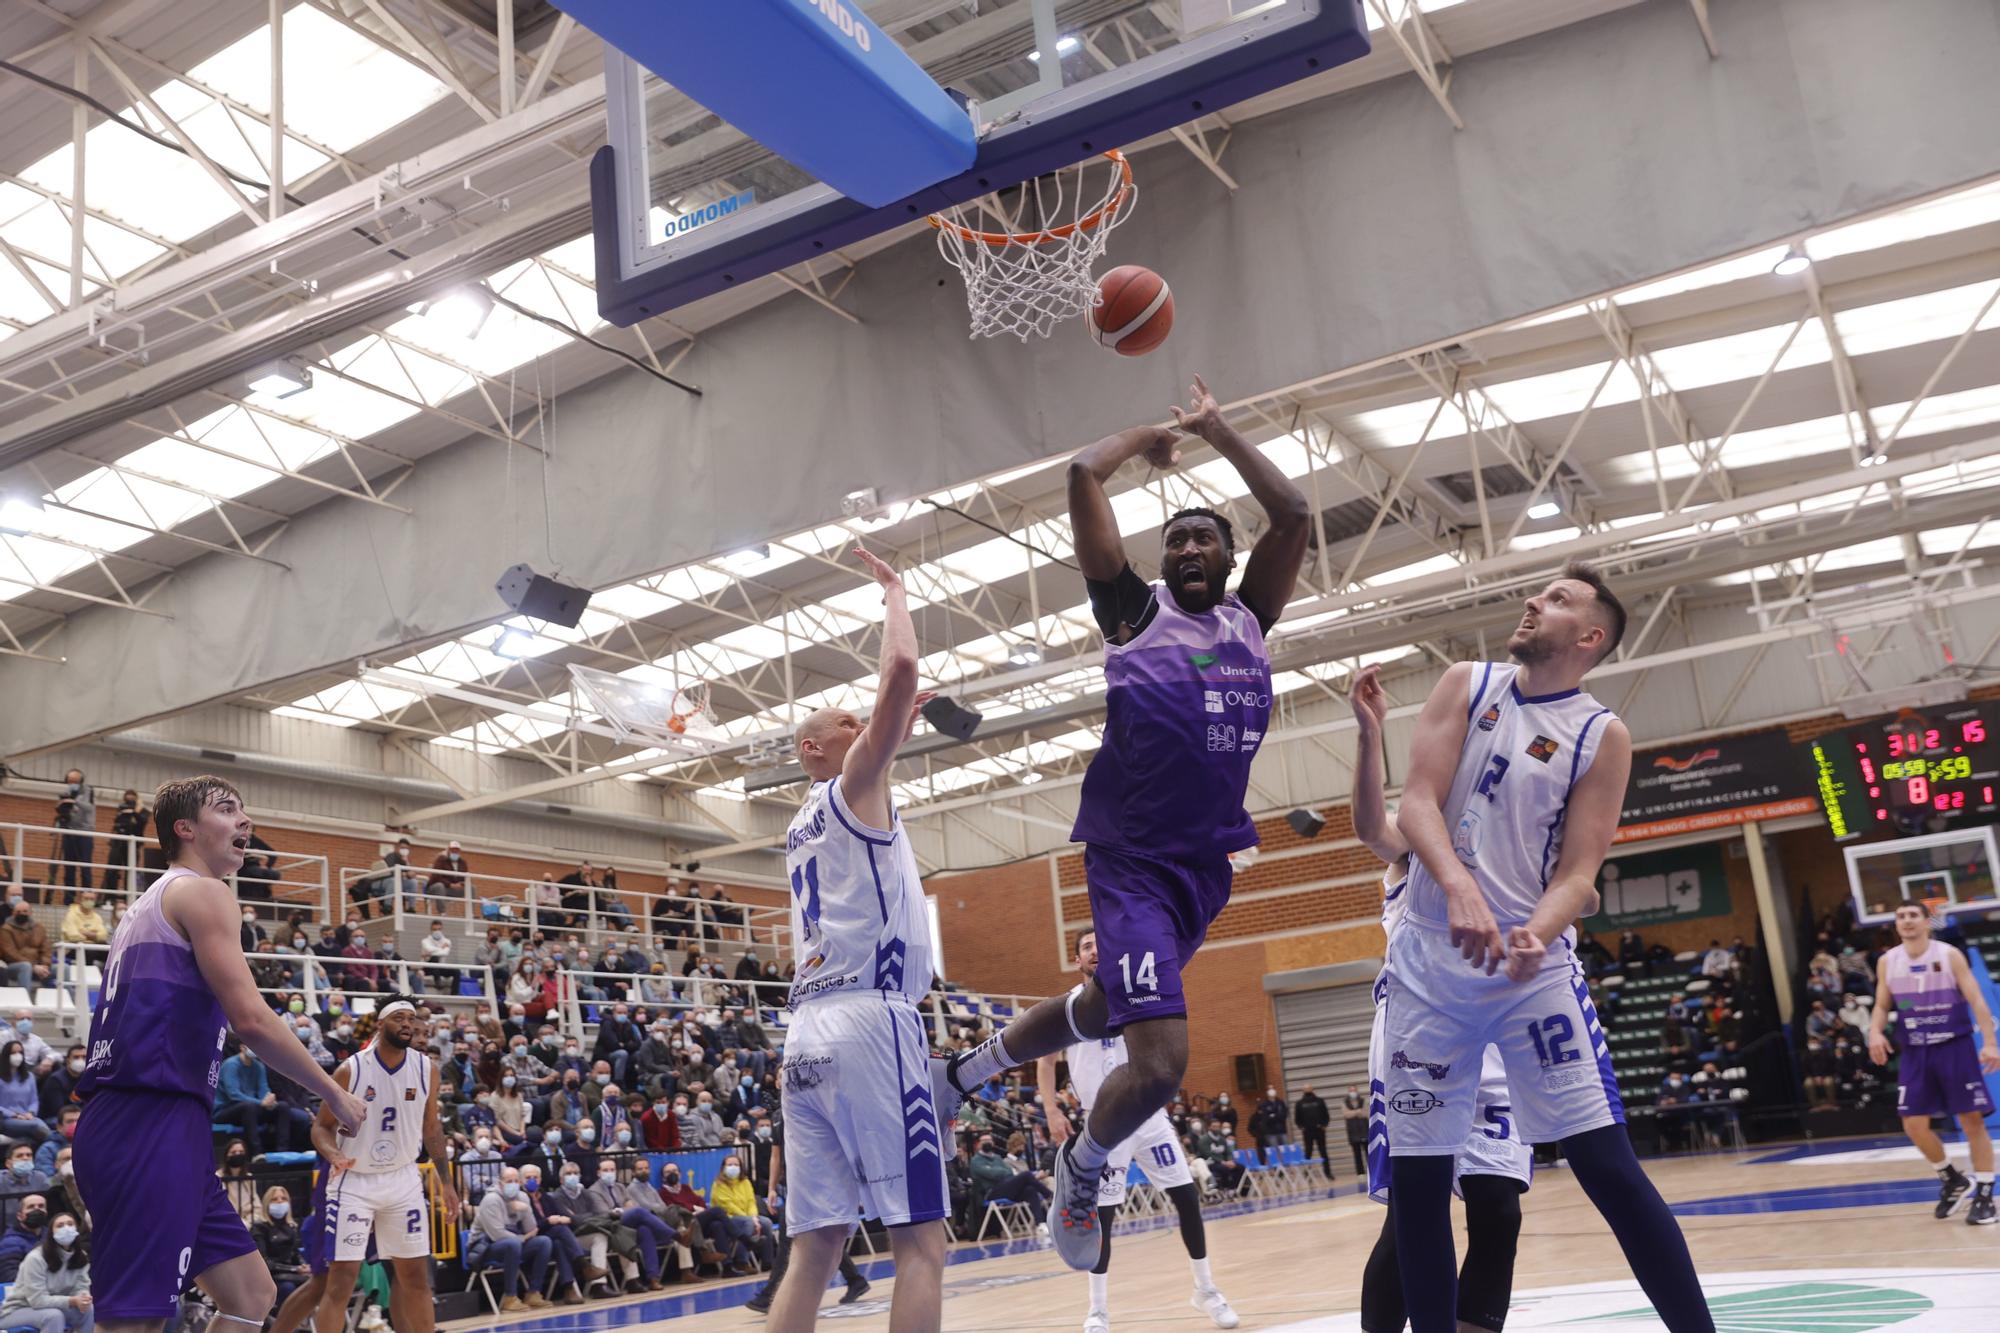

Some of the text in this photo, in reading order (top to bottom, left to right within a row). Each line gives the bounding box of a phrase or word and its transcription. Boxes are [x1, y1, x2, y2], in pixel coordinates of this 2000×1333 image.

[809, 0, 870, 52] NDO
[1220, 665, 1263, 678] Unicaa
[1621, 784, 1779, 819] WW.UNIONFINANCIERA.ES
[1907, 776, 1929, 804] 8
[1118, 951, 1158, 994] 14
[1528, 1013, 1581, 1068] 12
[381, 1106, 397, 1131] 2
[1483, 1105, 1511, 1140] 5
[1151, 1142, 1177, 1168] 10
[406, 1208, 421, 1234] 2
[178, 1246, 192, 1290] 9
